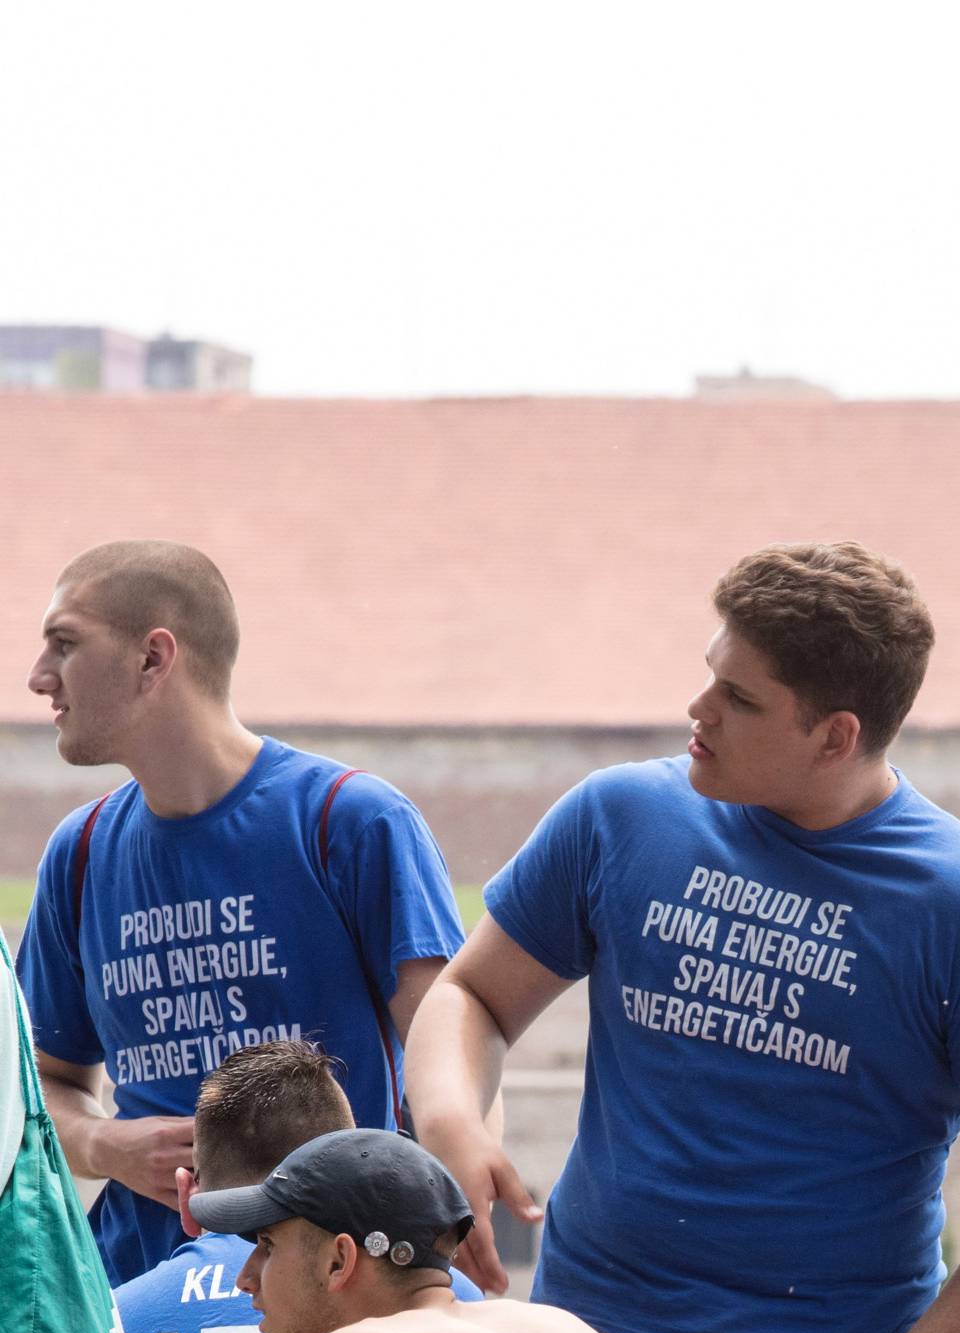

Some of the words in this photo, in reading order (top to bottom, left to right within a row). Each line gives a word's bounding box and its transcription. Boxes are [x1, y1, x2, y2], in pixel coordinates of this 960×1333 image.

[120, 899, 212, 950] PROBUDI
[220, 894, 255, 934] SE
[683, 865, 812, 928] PROBUDI
[810, 901, 853, 940] SE
[102, 952, 163, 1000] PUNA
[168, 938, 287, 987] ENERGIJE,
[642, 900, 719, 951] PUNA
[721, 921, 858, 995] ENERGIJE,
[142, 990, 224, 1036] SPAVAJ
[227, 986, 247, 1022] S
[673, 954, 780, 1012] SPAVAJ
[783, 983, 805, 1020] S
[622, 985, 851, 1074] ENERGETIČAROM
